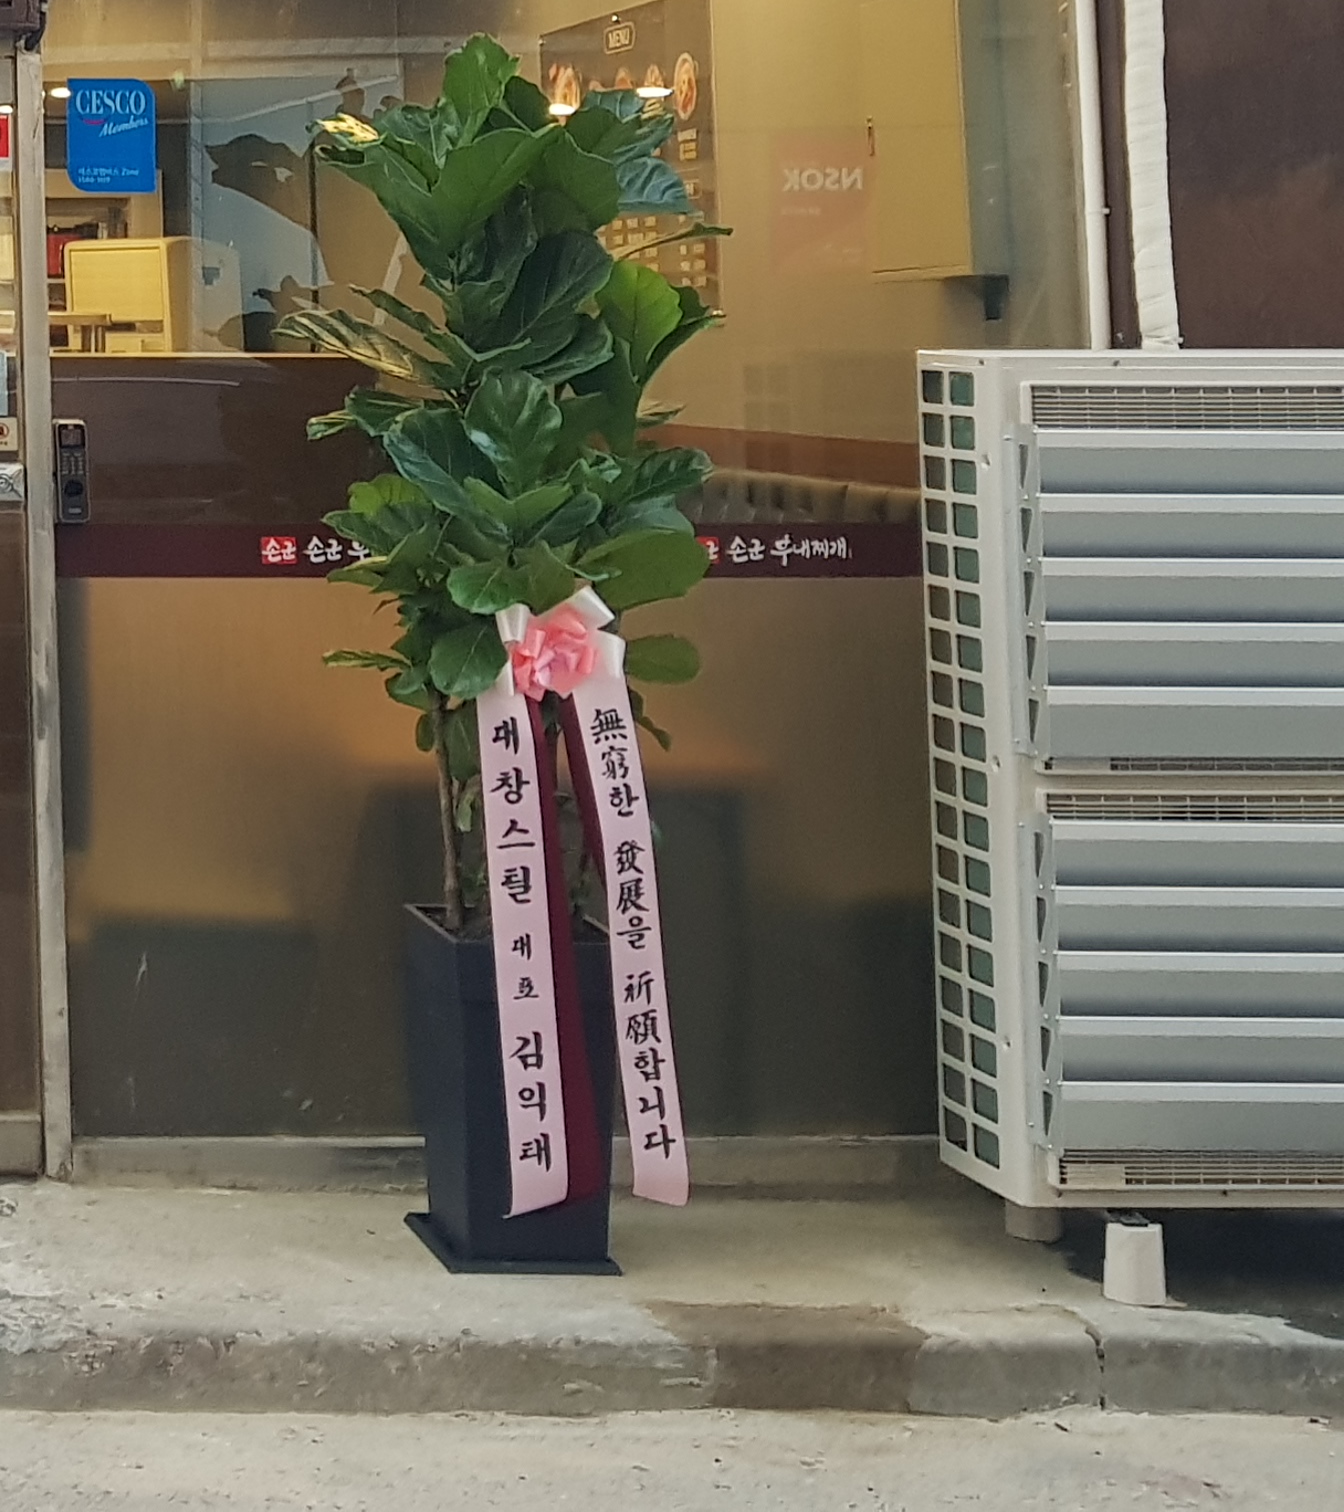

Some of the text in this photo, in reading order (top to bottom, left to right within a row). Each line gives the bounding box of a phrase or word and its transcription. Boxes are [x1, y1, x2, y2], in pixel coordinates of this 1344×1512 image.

[75, 89, 147, 116] CESCO
[98, 114, 149, 138] Members
[261, 537, 297, 563] 손군
[303, 535, 343, 564] 손군
[725, 535, 766, 564] 손군
[489, 716, 537, 905] 대창스틸
